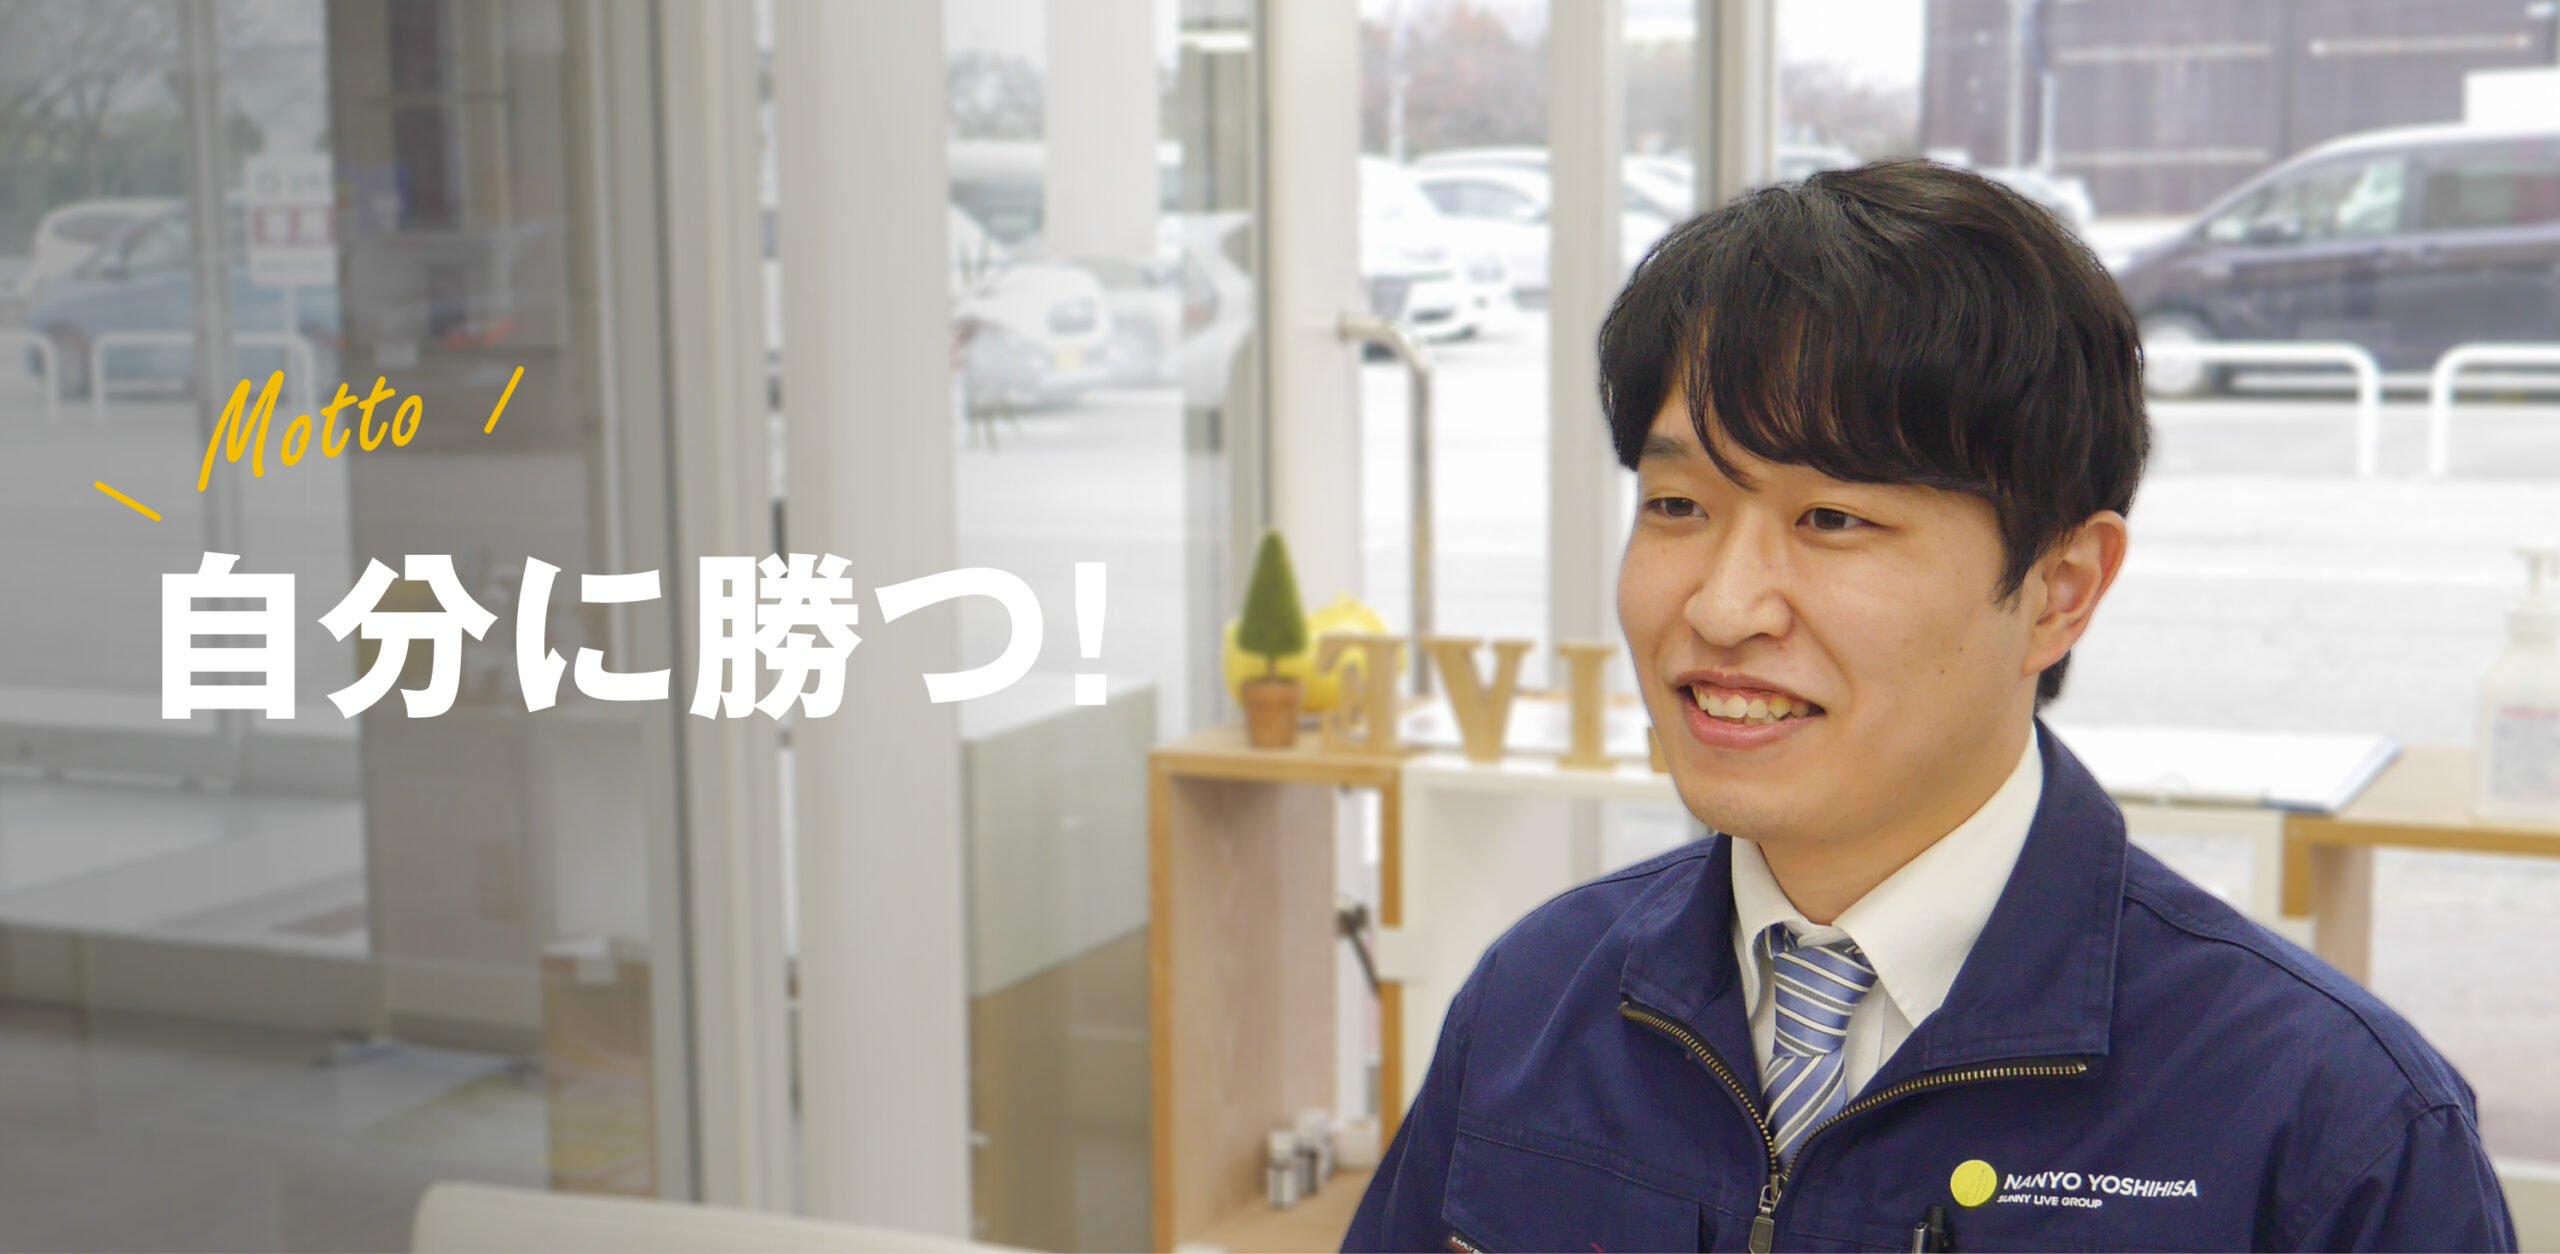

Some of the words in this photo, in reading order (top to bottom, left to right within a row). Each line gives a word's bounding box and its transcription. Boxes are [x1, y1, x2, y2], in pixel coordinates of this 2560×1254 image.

[2003, 1171, 2082, 1191] NANYO
[2087, 1173, 2198, 1197] YOSHIHISA
[1997, 1194, 2031, 1204] SUNNY
[2033, 1195, 2059, 1206] LIVE
[2061, 1196, 2103, 1209] GROUP
